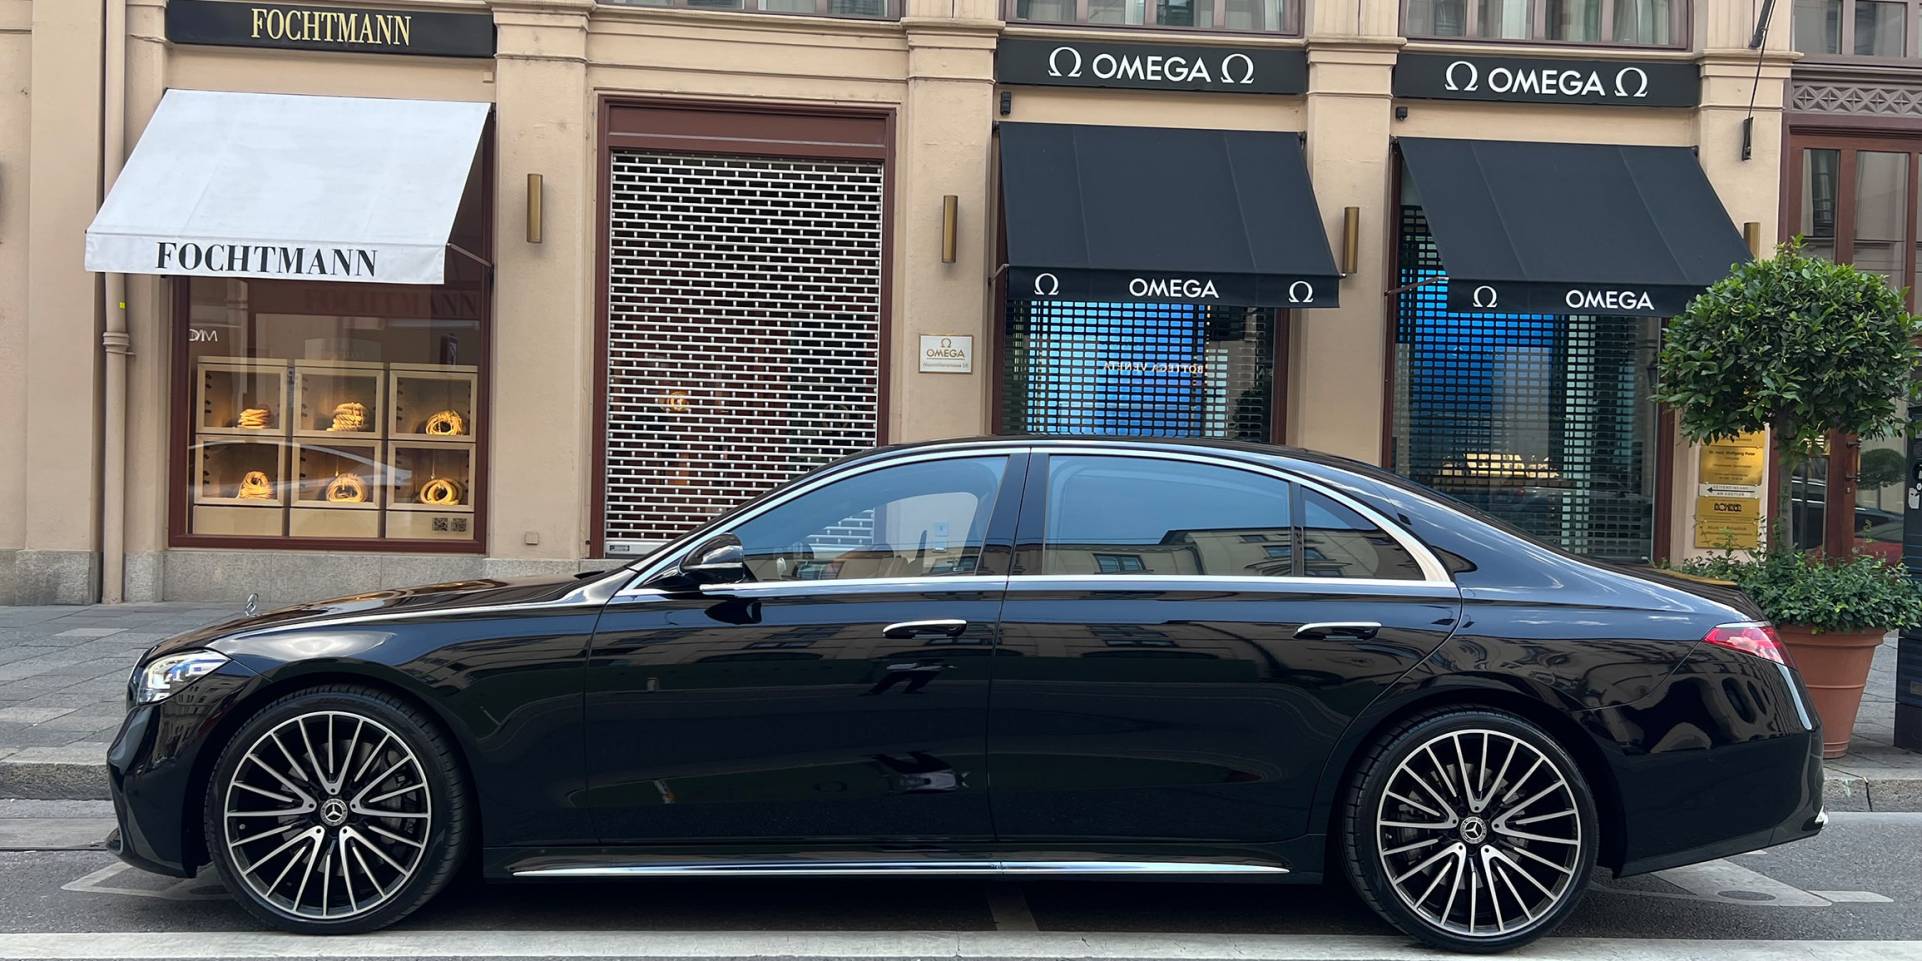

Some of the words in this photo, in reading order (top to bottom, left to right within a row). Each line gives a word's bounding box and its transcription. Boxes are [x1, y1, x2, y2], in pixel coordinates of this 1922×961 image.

[250, 8, 411, 46] FOCHTMANN
[1092, 53, 1212, 83] OMEGA
[1487, 67, 1606, 96] OMEGA
[156, 241, 379, 278] FOCHTMANN
[1129, 278, 1220, 299] OMEGA
[1565, 289, 1655, 311] OMEGA
[926, 348, 965, 358] OMEGA
